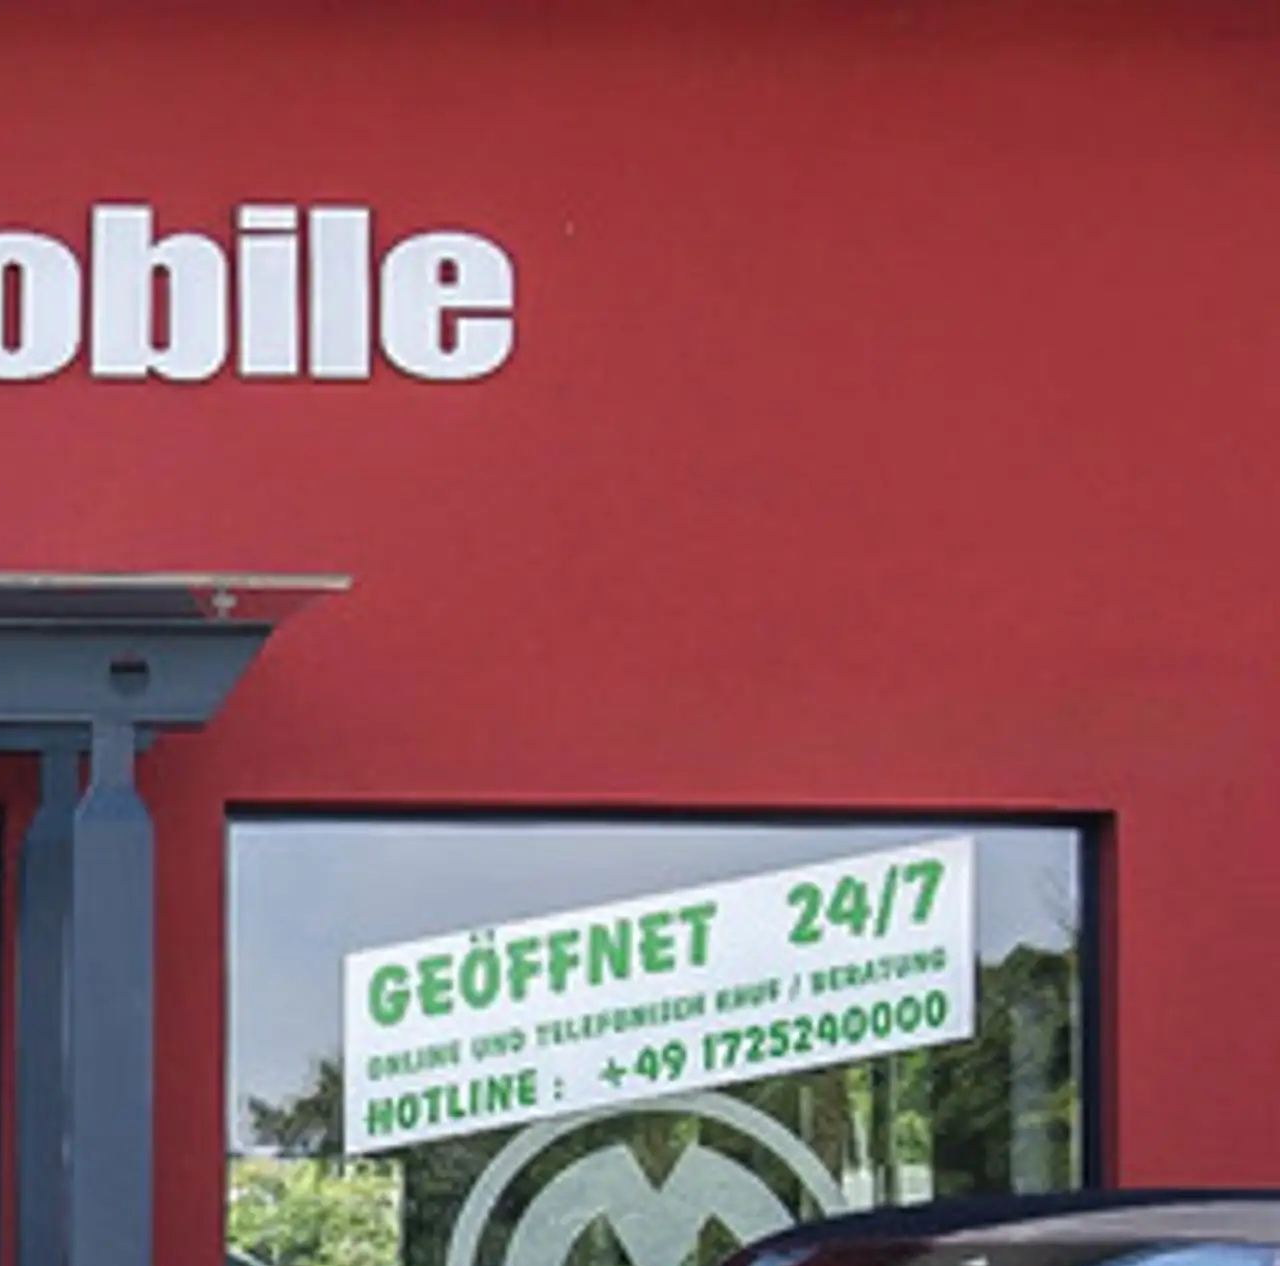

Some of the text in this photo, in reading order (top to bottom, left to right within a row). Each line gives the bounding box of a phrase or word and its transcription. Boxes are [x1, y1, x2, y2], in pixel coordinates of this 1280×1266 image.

[366, 1040, 460, 1080] ONLINE
[471, 1028, 527, 1061] UND
[536, 993, 707, 1046] TELEFONISCH
[714, 977, 781, 1013] KAUF
[809, 946, 948, 996] BERATUNG
[367, 859, 943, 1026] GEÖFFNET 24/7
[365, 1068, 538, 1135] HOTLINE
[598, 1039, 687, 1088] +49
[703, 988, 950, 1070] 1725240000
